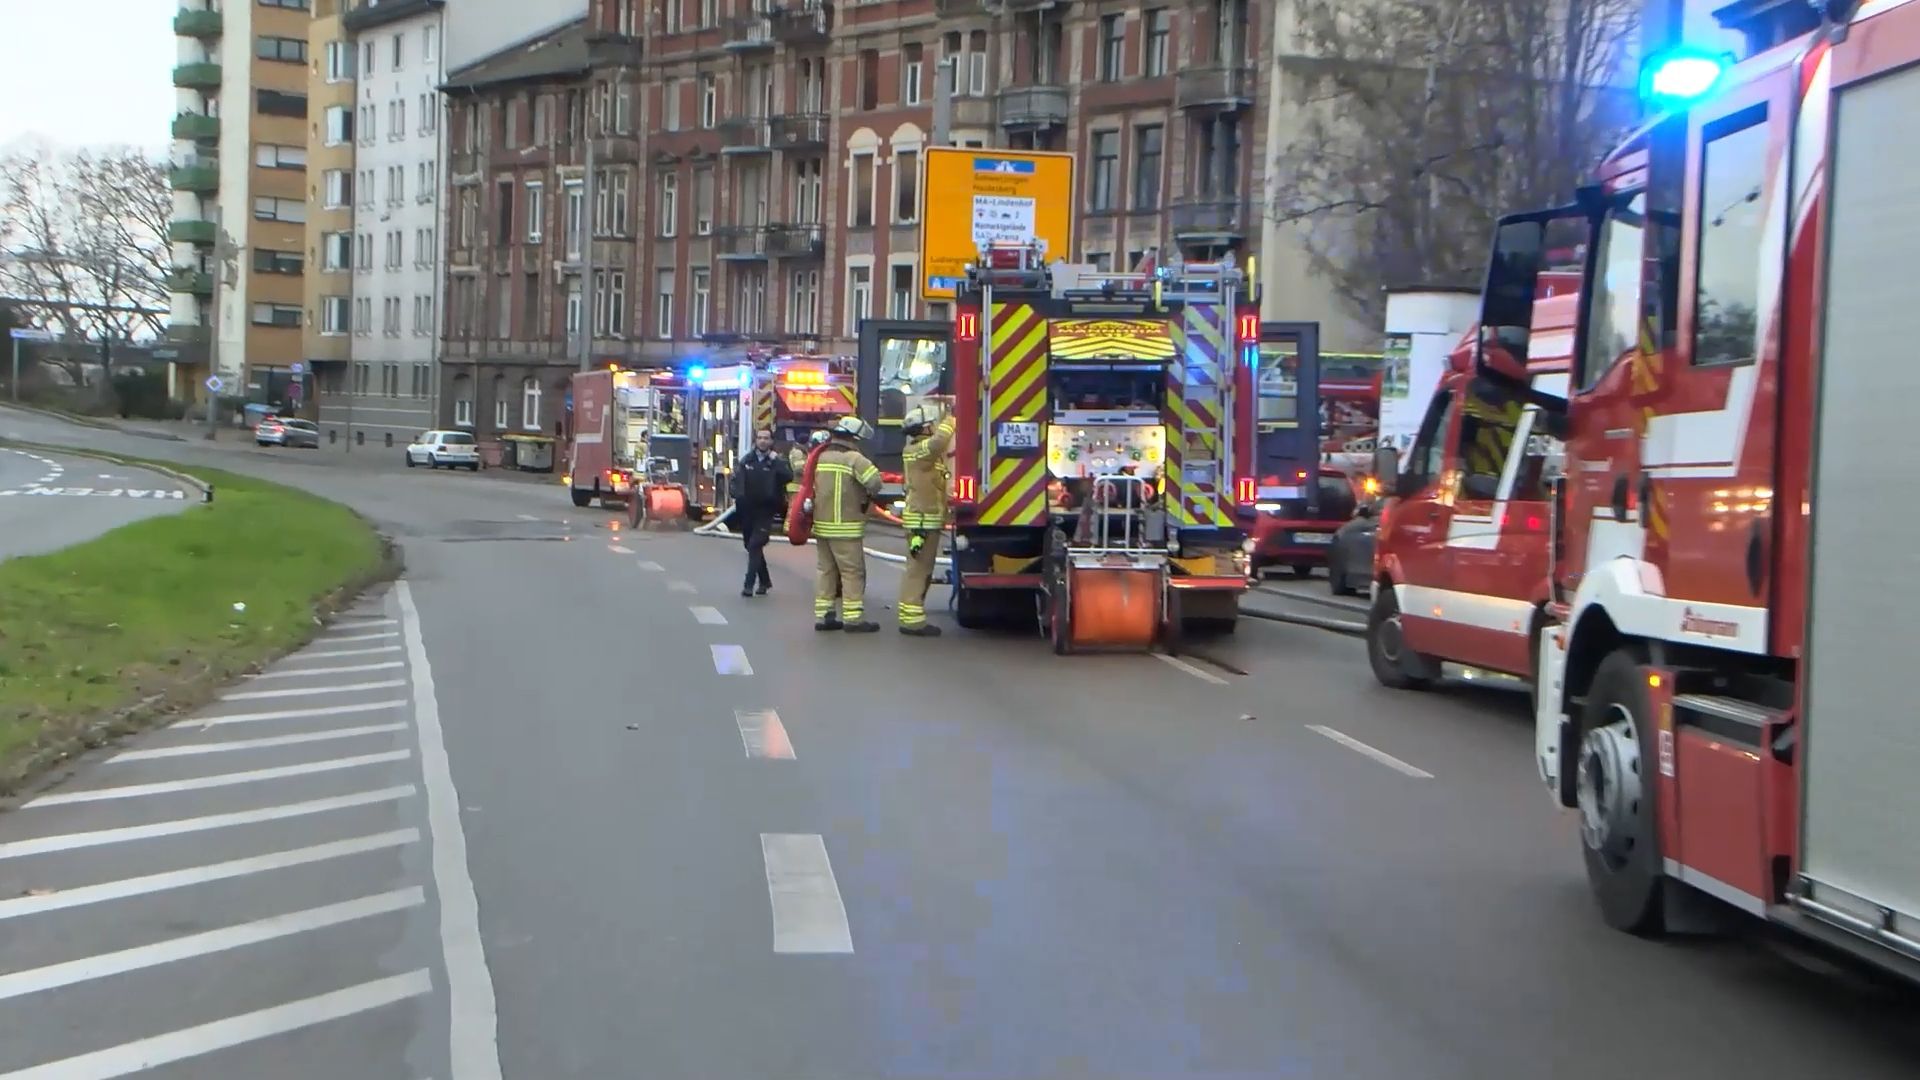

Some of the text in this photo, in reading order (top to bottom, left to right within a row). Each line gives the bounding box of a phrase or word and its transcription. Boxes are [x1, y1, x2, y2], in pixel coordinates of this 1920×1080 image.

[1006, 424, 1021, 434] MA
[1003, 435, 1032, 445] F 251
[24, 487, 184, 500] HAFEN
